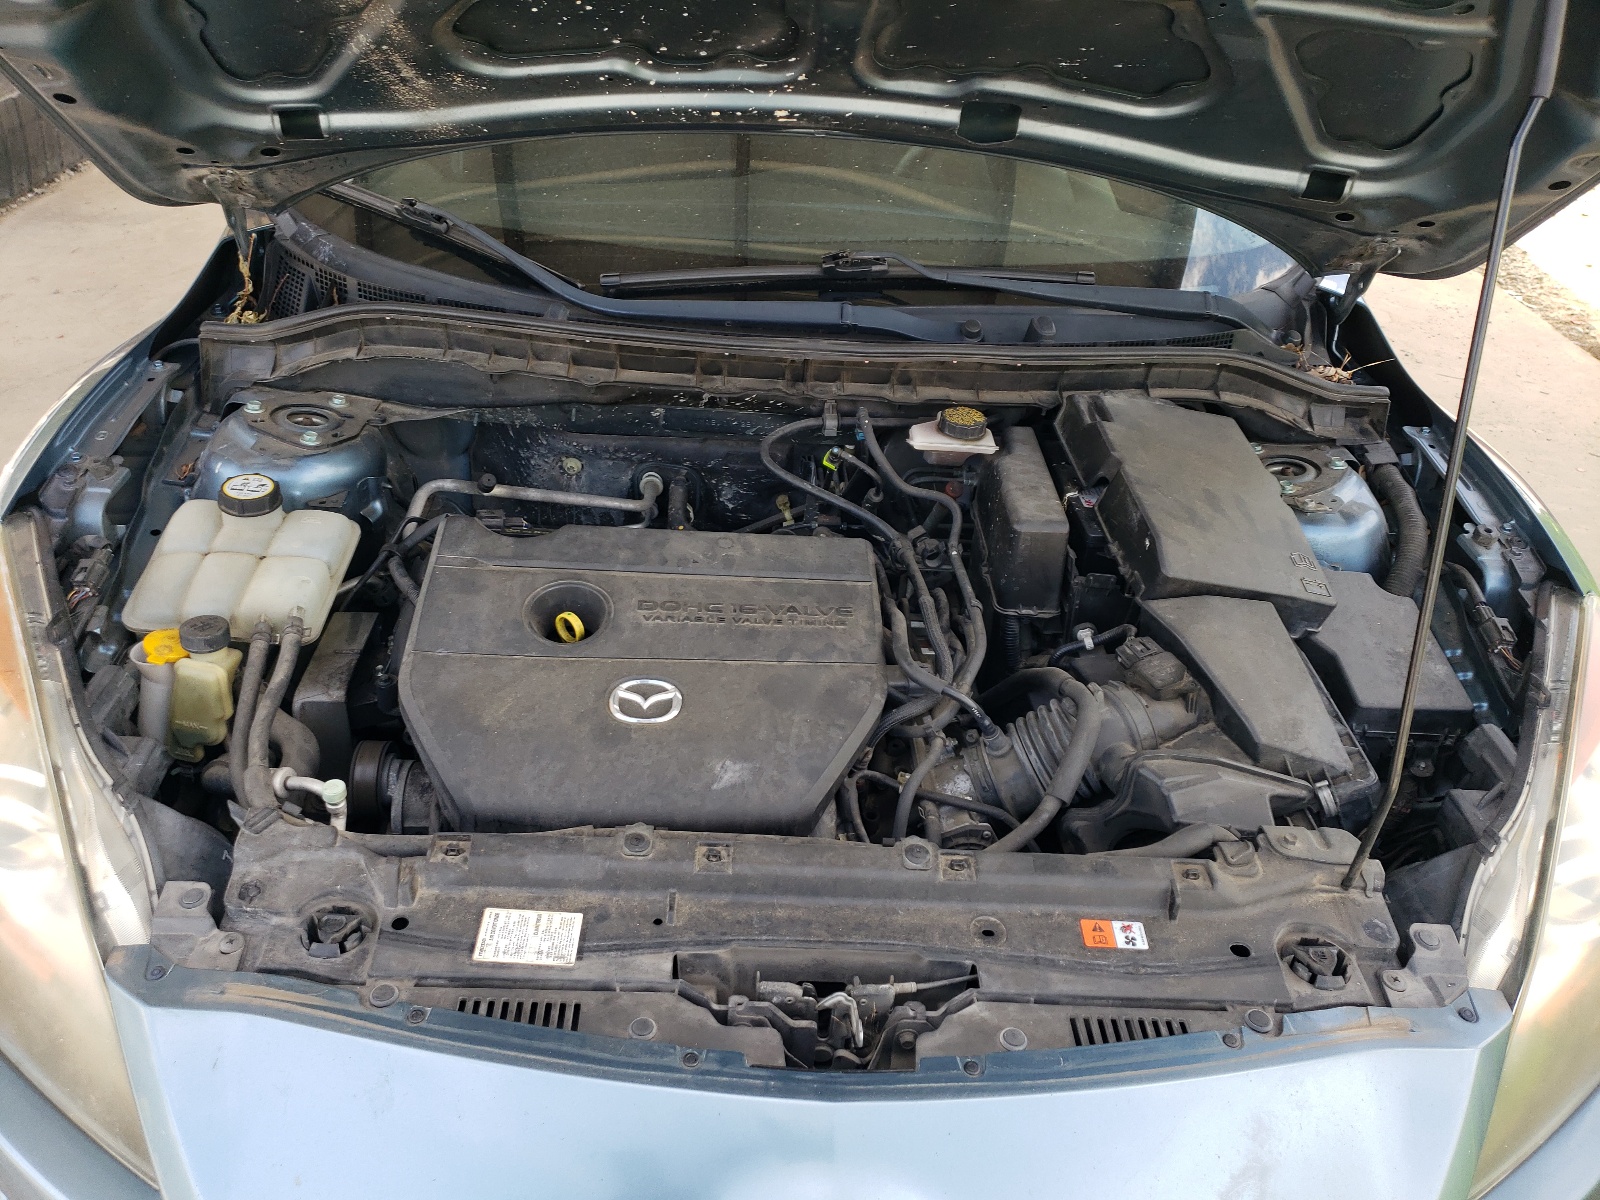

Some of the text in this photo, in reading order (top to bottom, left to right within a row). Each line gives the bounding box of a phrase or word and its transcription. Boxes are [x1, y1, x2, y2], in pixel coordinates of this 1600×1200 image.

[637, 600, 854, 618] DOHC 16-VALVE
[642, 614, 848, 628] VARIABLE VALVE TIMING
